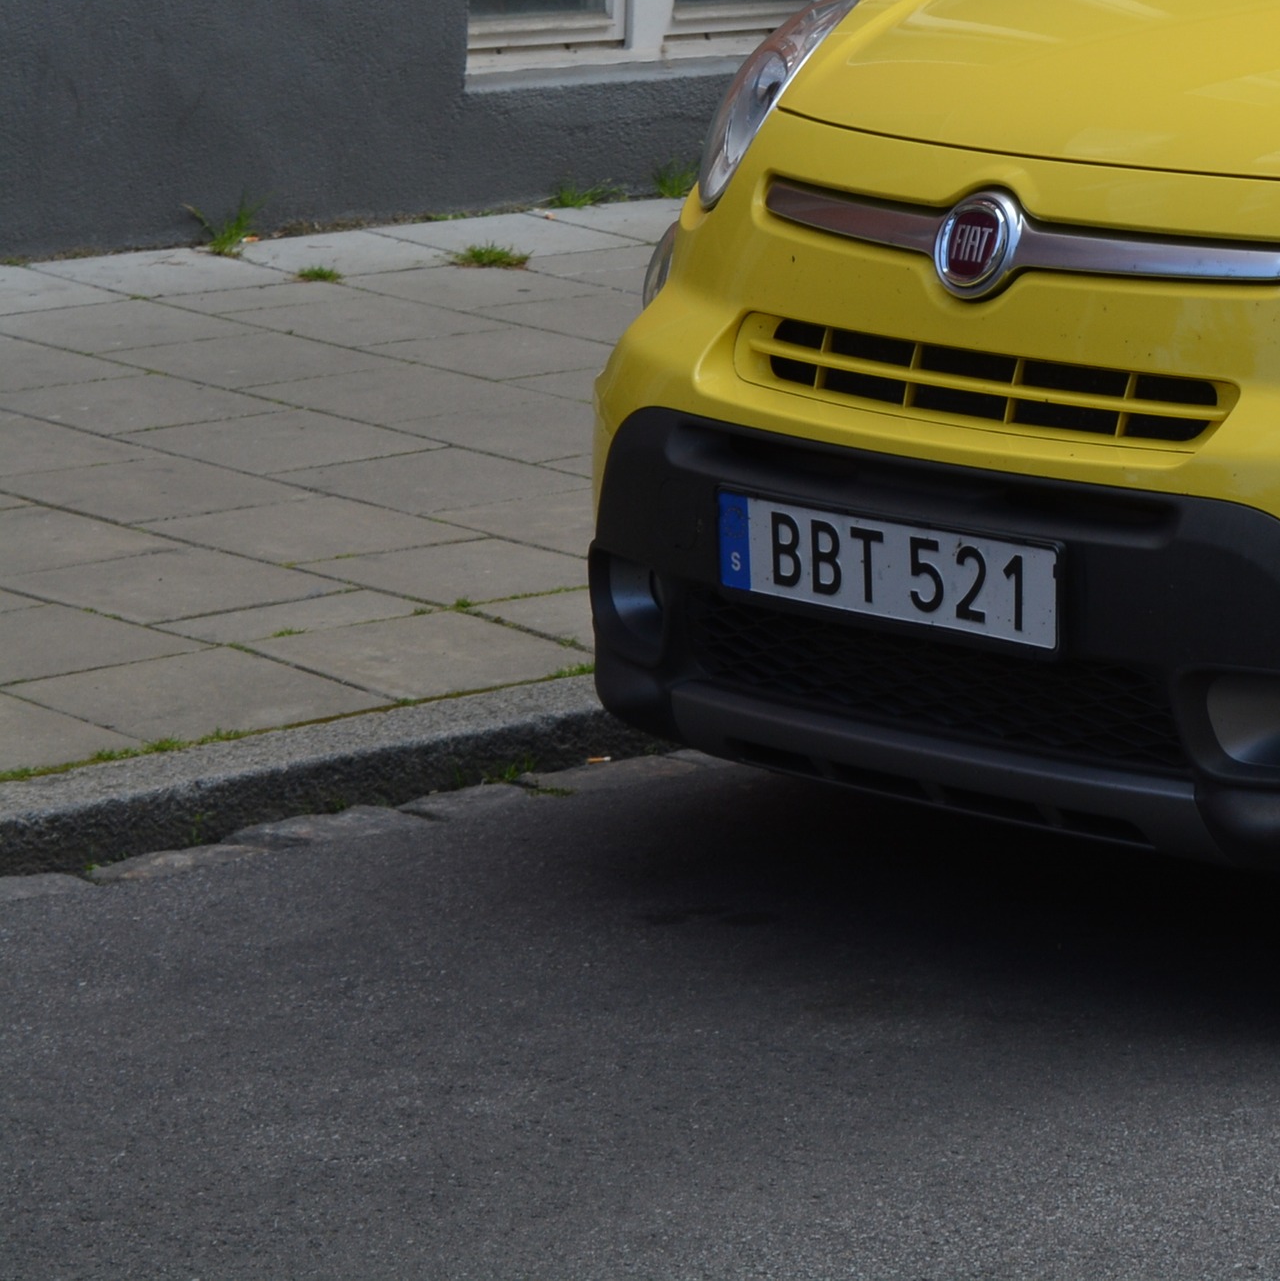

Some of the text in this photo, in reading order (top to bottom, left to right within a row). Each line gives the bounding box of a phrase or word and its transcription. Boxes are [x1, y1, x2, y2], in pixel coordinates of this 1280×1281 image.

[951, 224, 993, 263] FIAT
[731, 552, 742, 572] S
[771, 511, 1023, 632] BBT 521
